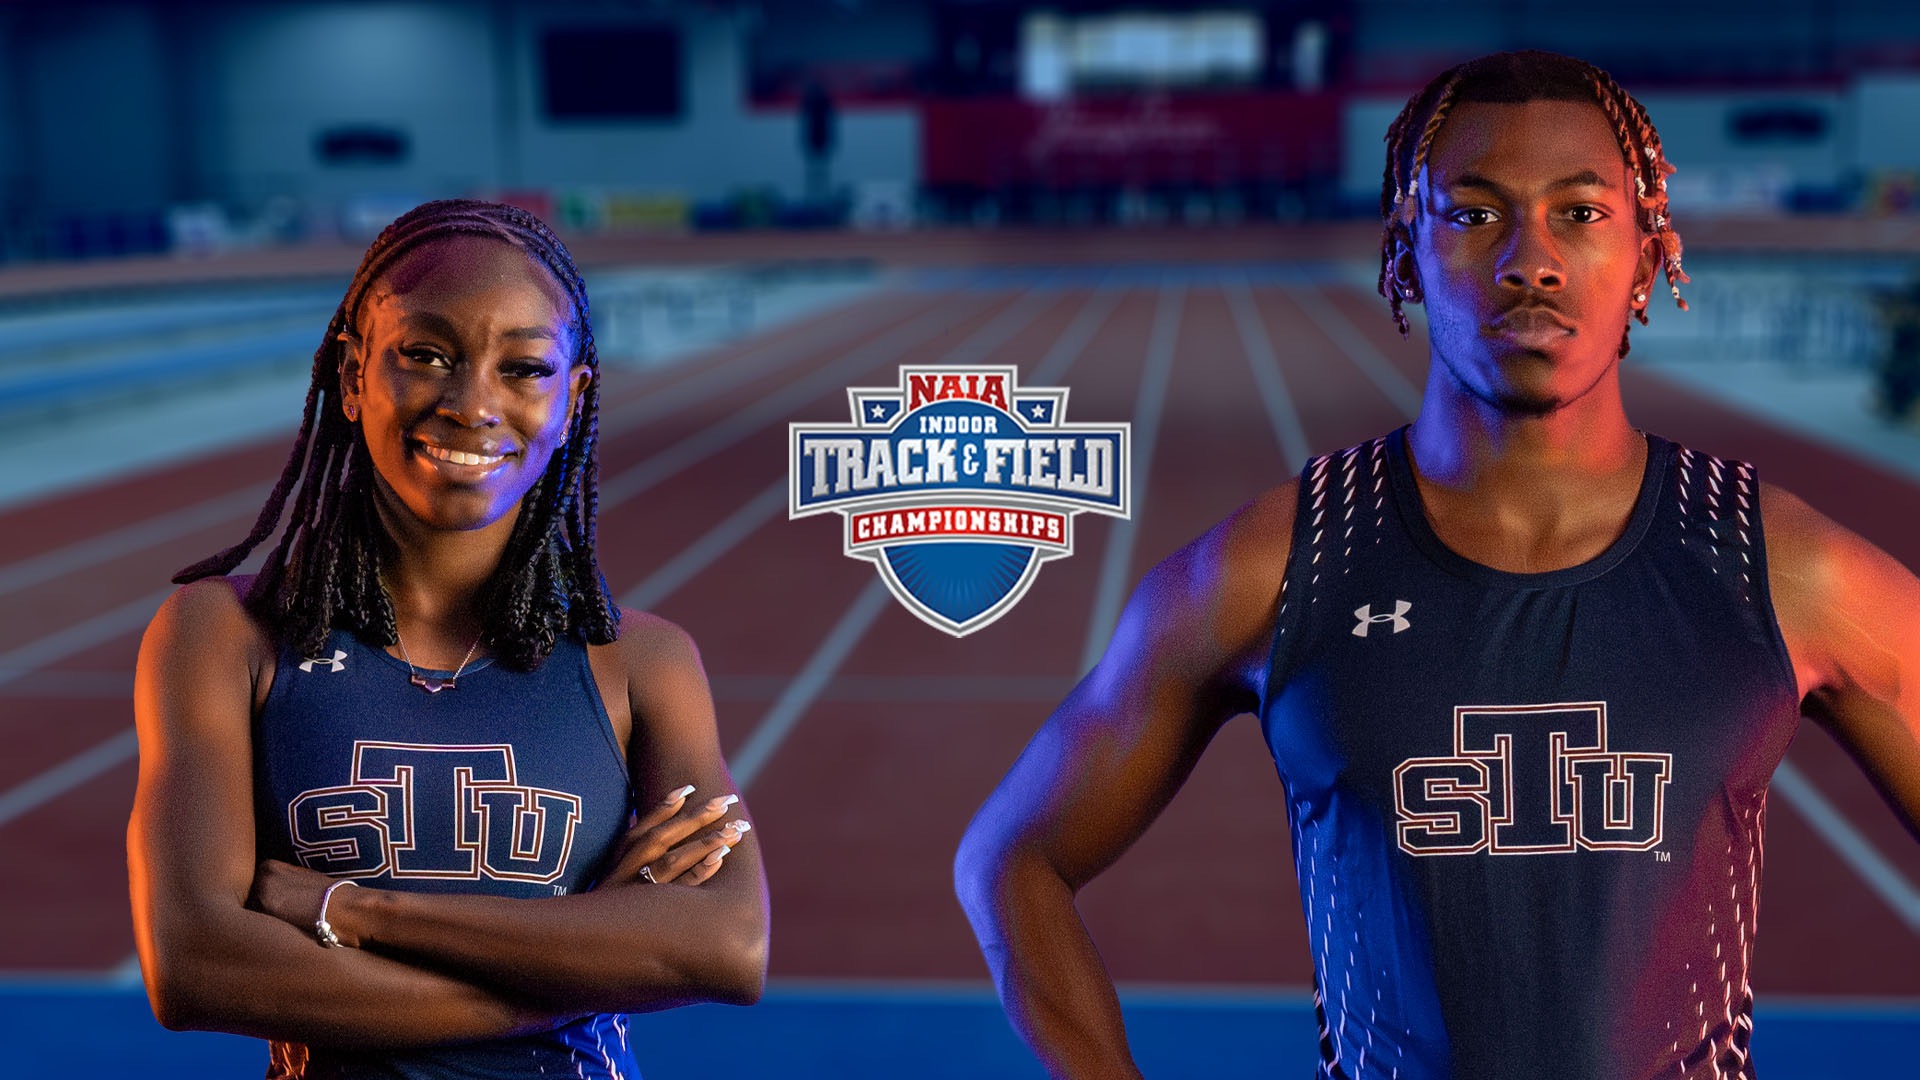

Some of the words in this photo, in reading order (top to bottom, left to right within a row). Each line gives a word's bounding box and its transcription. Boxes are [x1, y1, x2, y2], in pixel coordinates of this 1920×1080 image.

[288, 740, 582, 885] STU
[1393, 701, 1673, 857] STU
[552, 884, 568, 897] TM
[1654, 850, 1671, 863] TM
